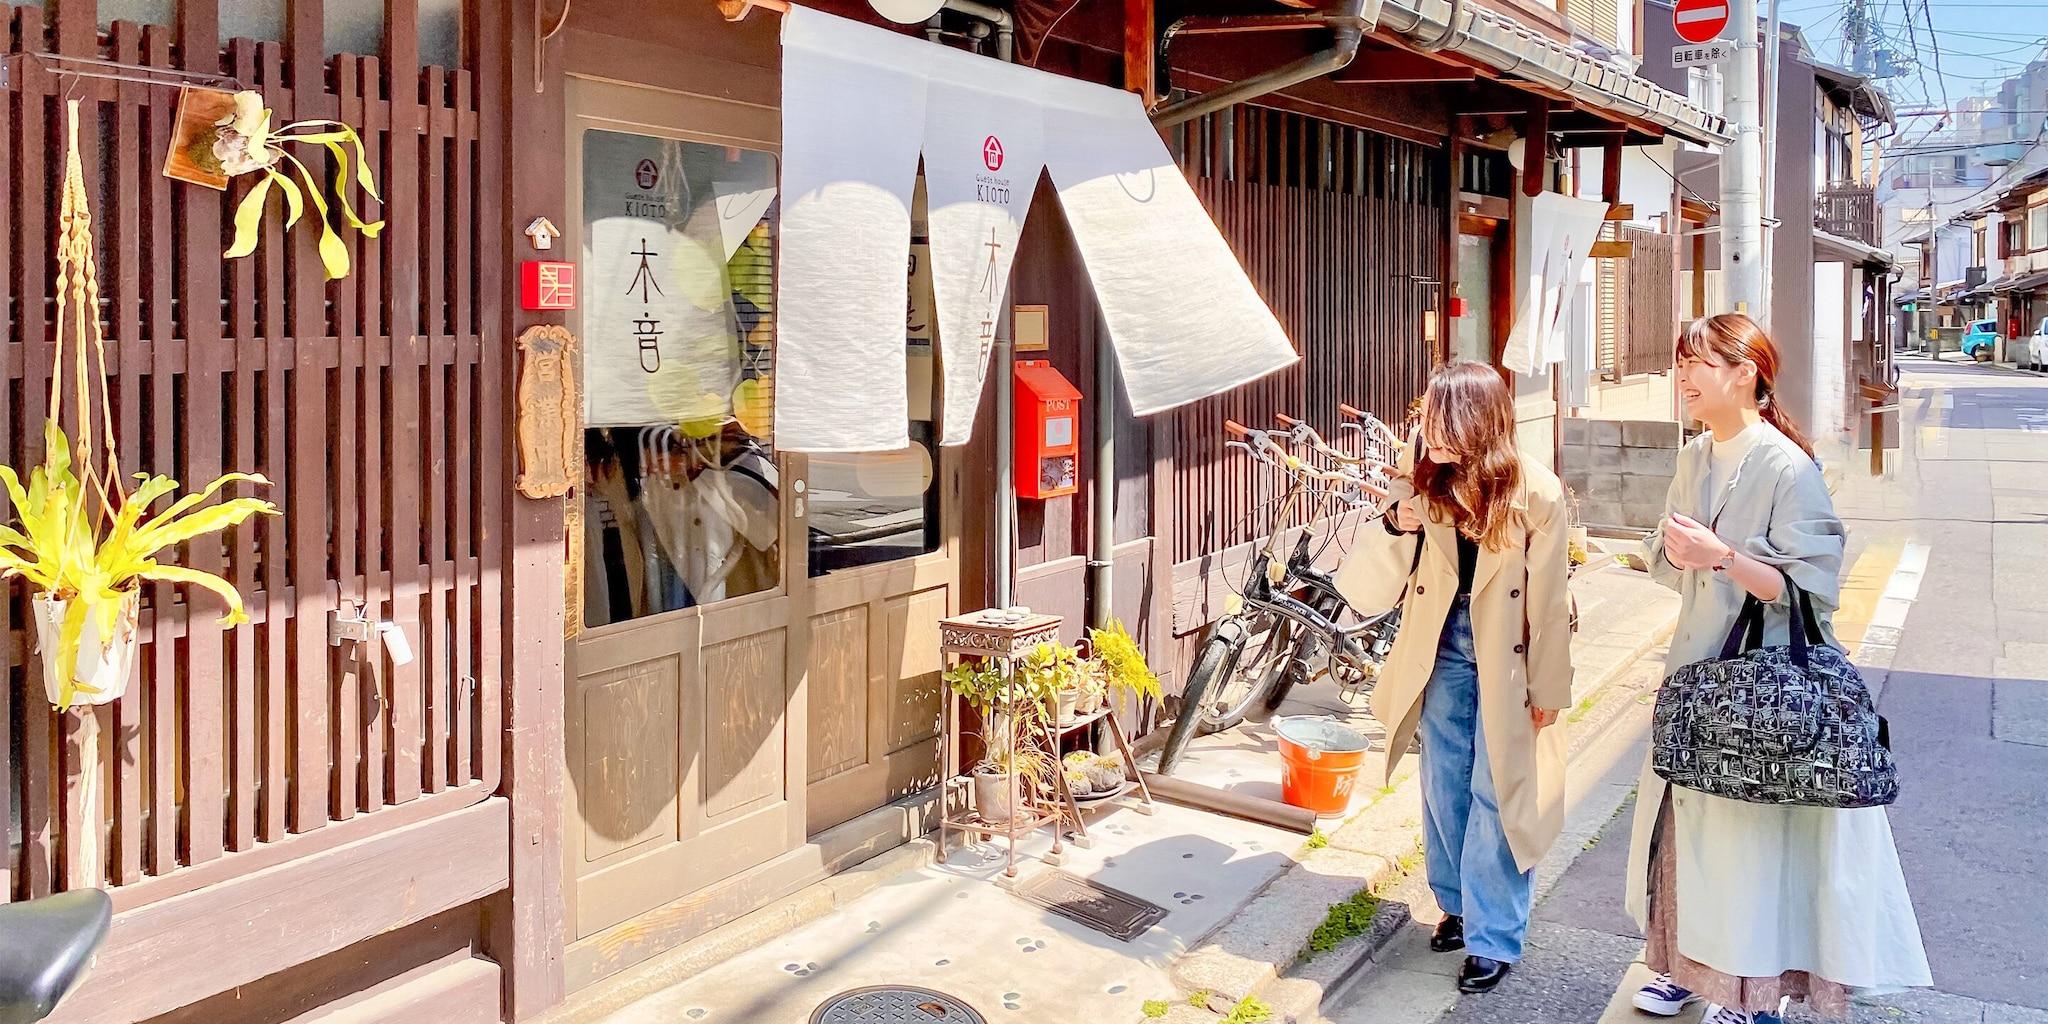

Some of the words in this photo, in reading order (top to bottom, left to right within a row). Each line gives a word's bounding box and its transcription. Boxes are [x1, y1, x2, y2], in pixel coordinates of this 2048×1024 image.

[1674, 47, 1727, 63] 自転車を除く
[977, 184, 1010, 204] KIOTO
[624, 201, 666, 217] KIOTO
[625, 237, 665, 374] 木音
[979, 226, 1002, 383] 木音
[1045, 399, 1072, 412] POST
